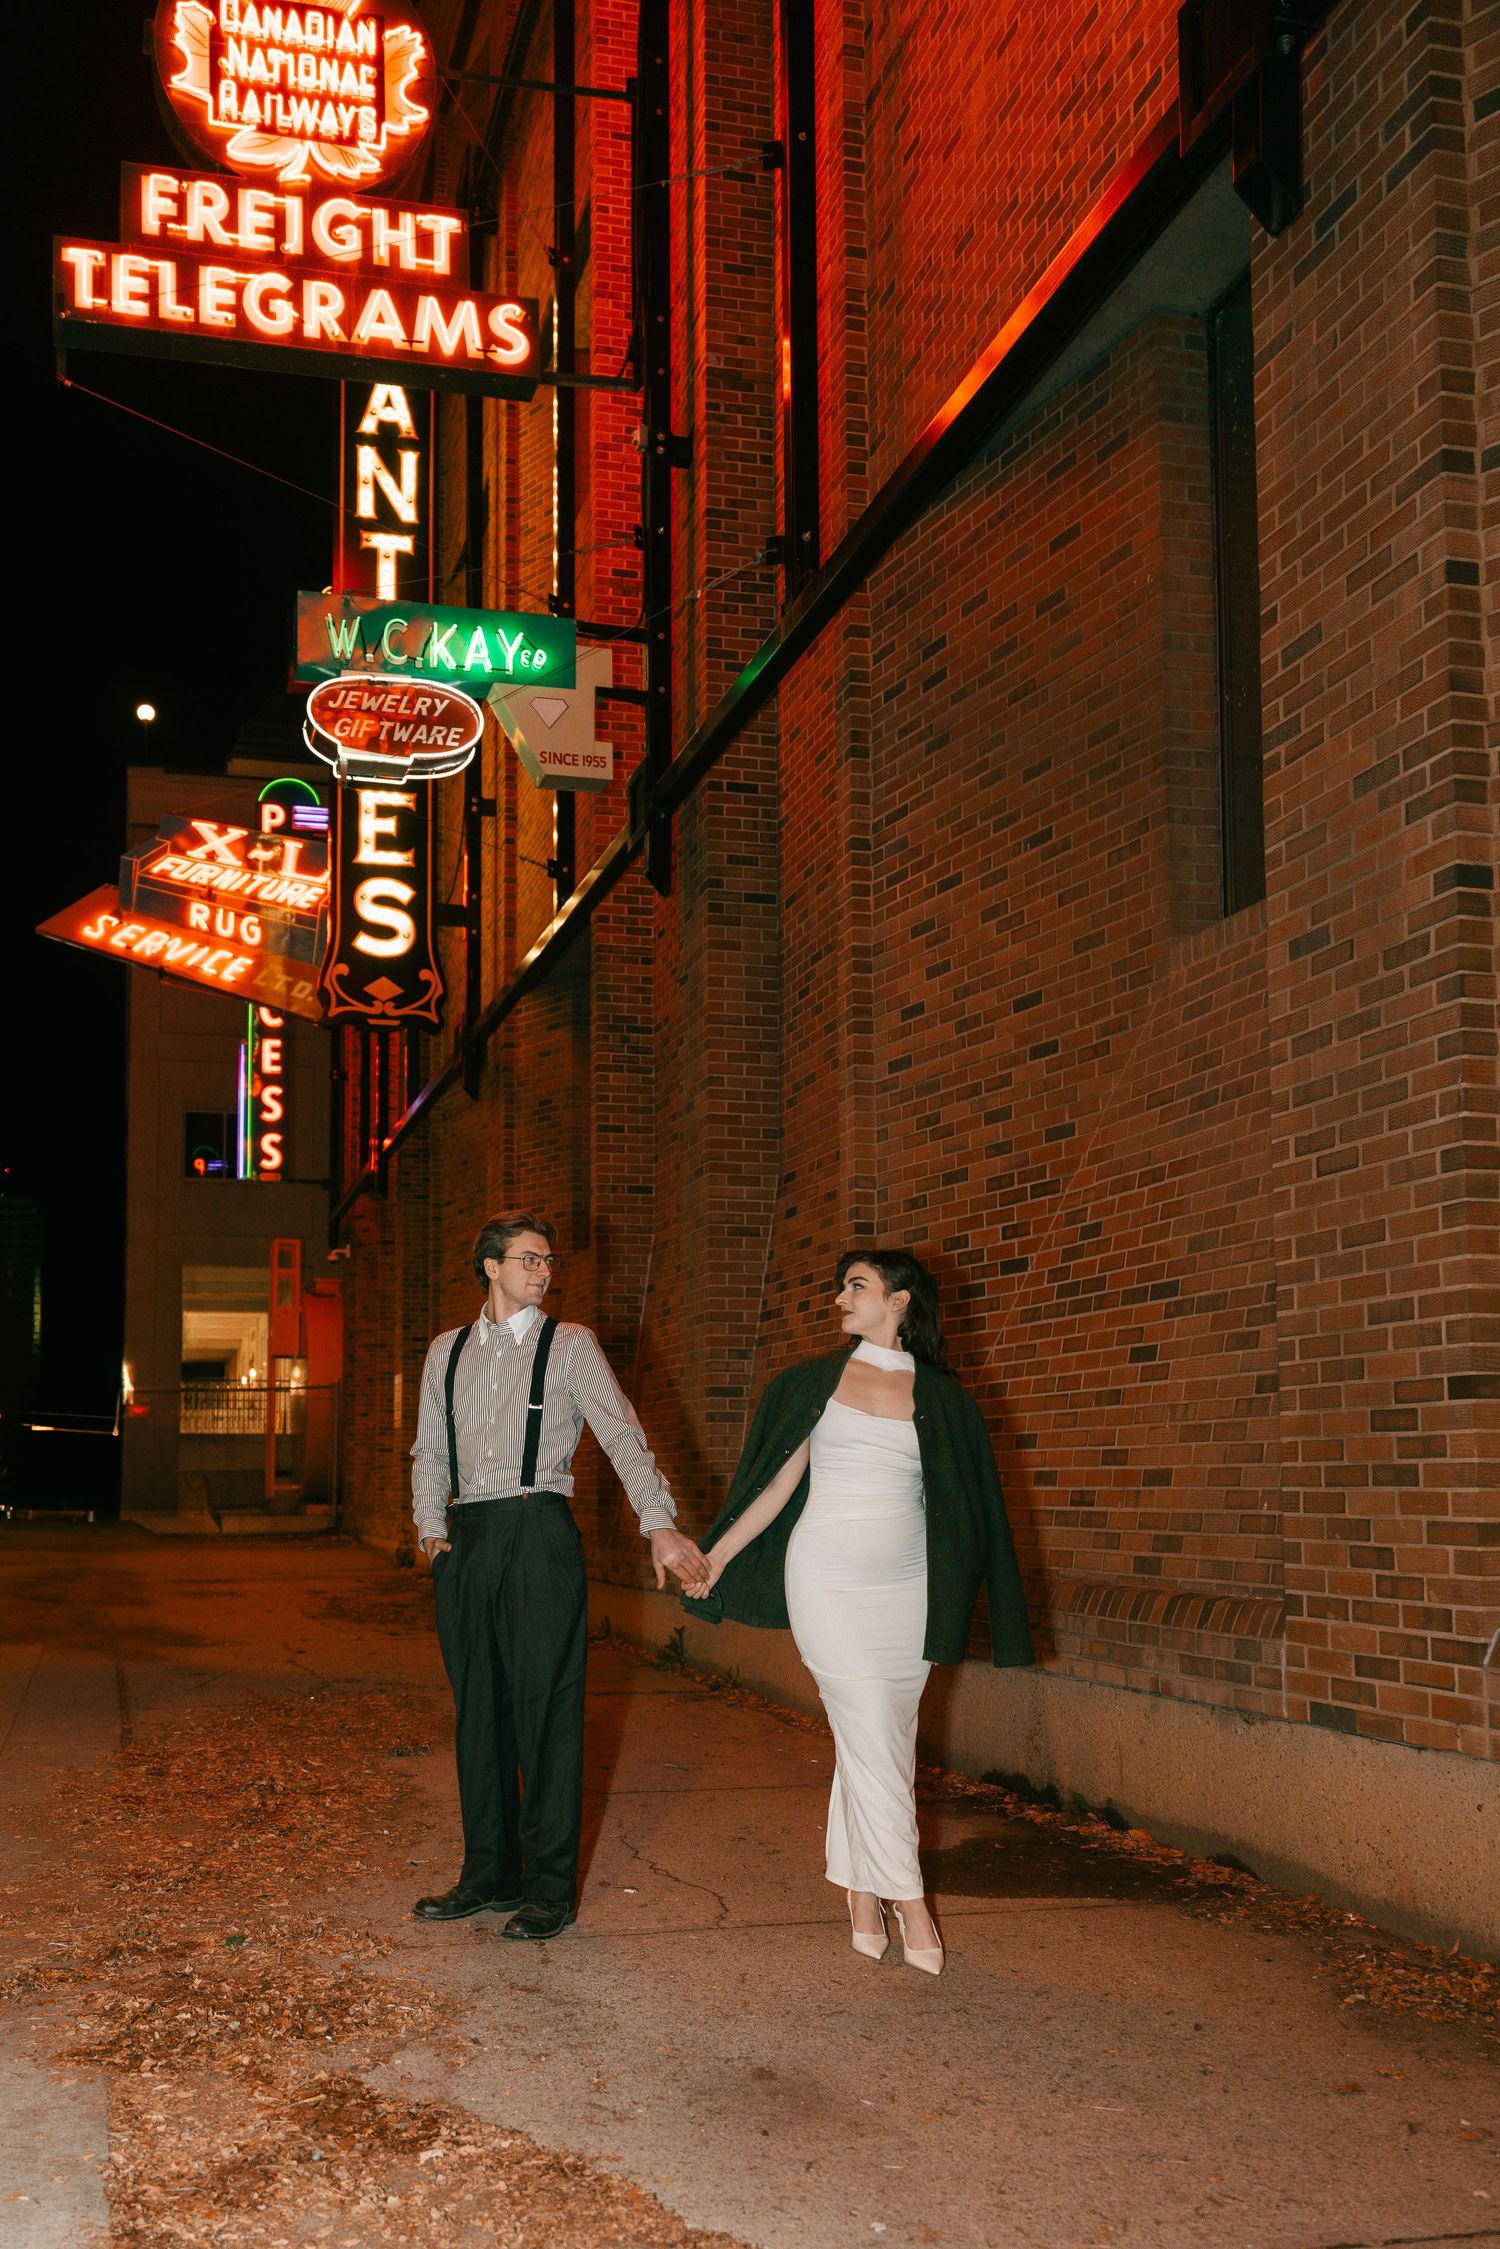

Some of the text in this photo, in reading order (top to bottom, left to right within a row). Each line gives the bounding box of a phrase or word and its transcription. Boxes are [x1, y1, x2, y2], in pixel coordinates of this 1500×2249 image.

[219, 0, 377, 57] CANADIAN
[227, 38, 377, 100] NATIONAL
[219, 79, 378, 140] RAILWAYS
[141, 172, 462, 275] FREIGHT
[62, 246, 532, 365] TELEGRAMS
[328, 689, 450, 718] JEWELRY
[539, 750, 607, 769] SINCE 1955
[151, 855, 328, 910] FURNITURE
[82, 914, 255, 983] SERVICE
[189, 902, 263, 946] RUG
